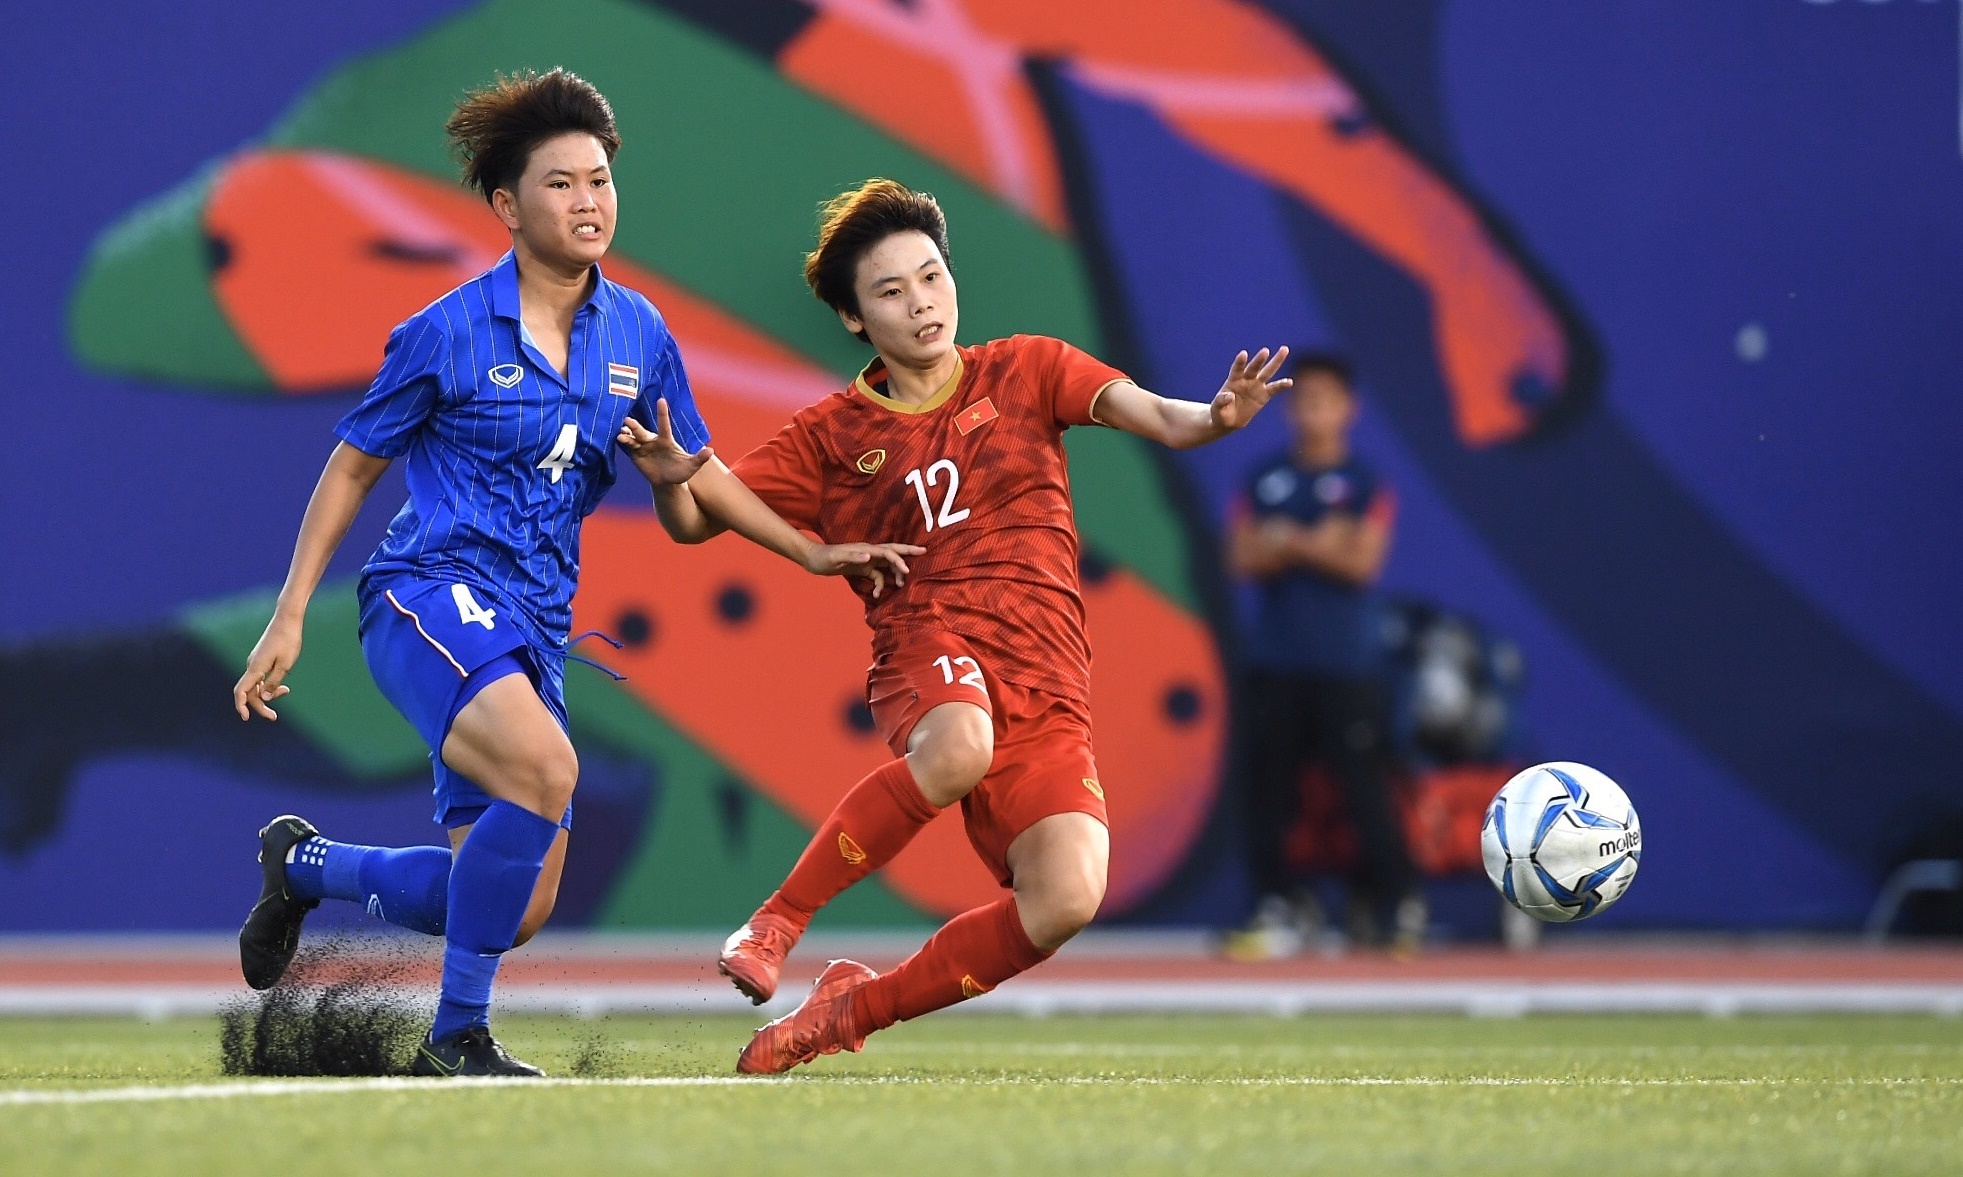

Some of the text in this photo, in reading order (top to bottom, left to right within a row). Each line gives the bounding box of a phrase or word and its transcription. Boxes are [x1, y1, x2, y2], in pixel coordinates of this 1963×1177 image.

[536, 424, 578, 484] 4
[904, 458, 971, 533] 12
[451, 583, 496, 630] 4
[932, 654, 988, 696] 12
[1599, 828, 1641, 857] molte
